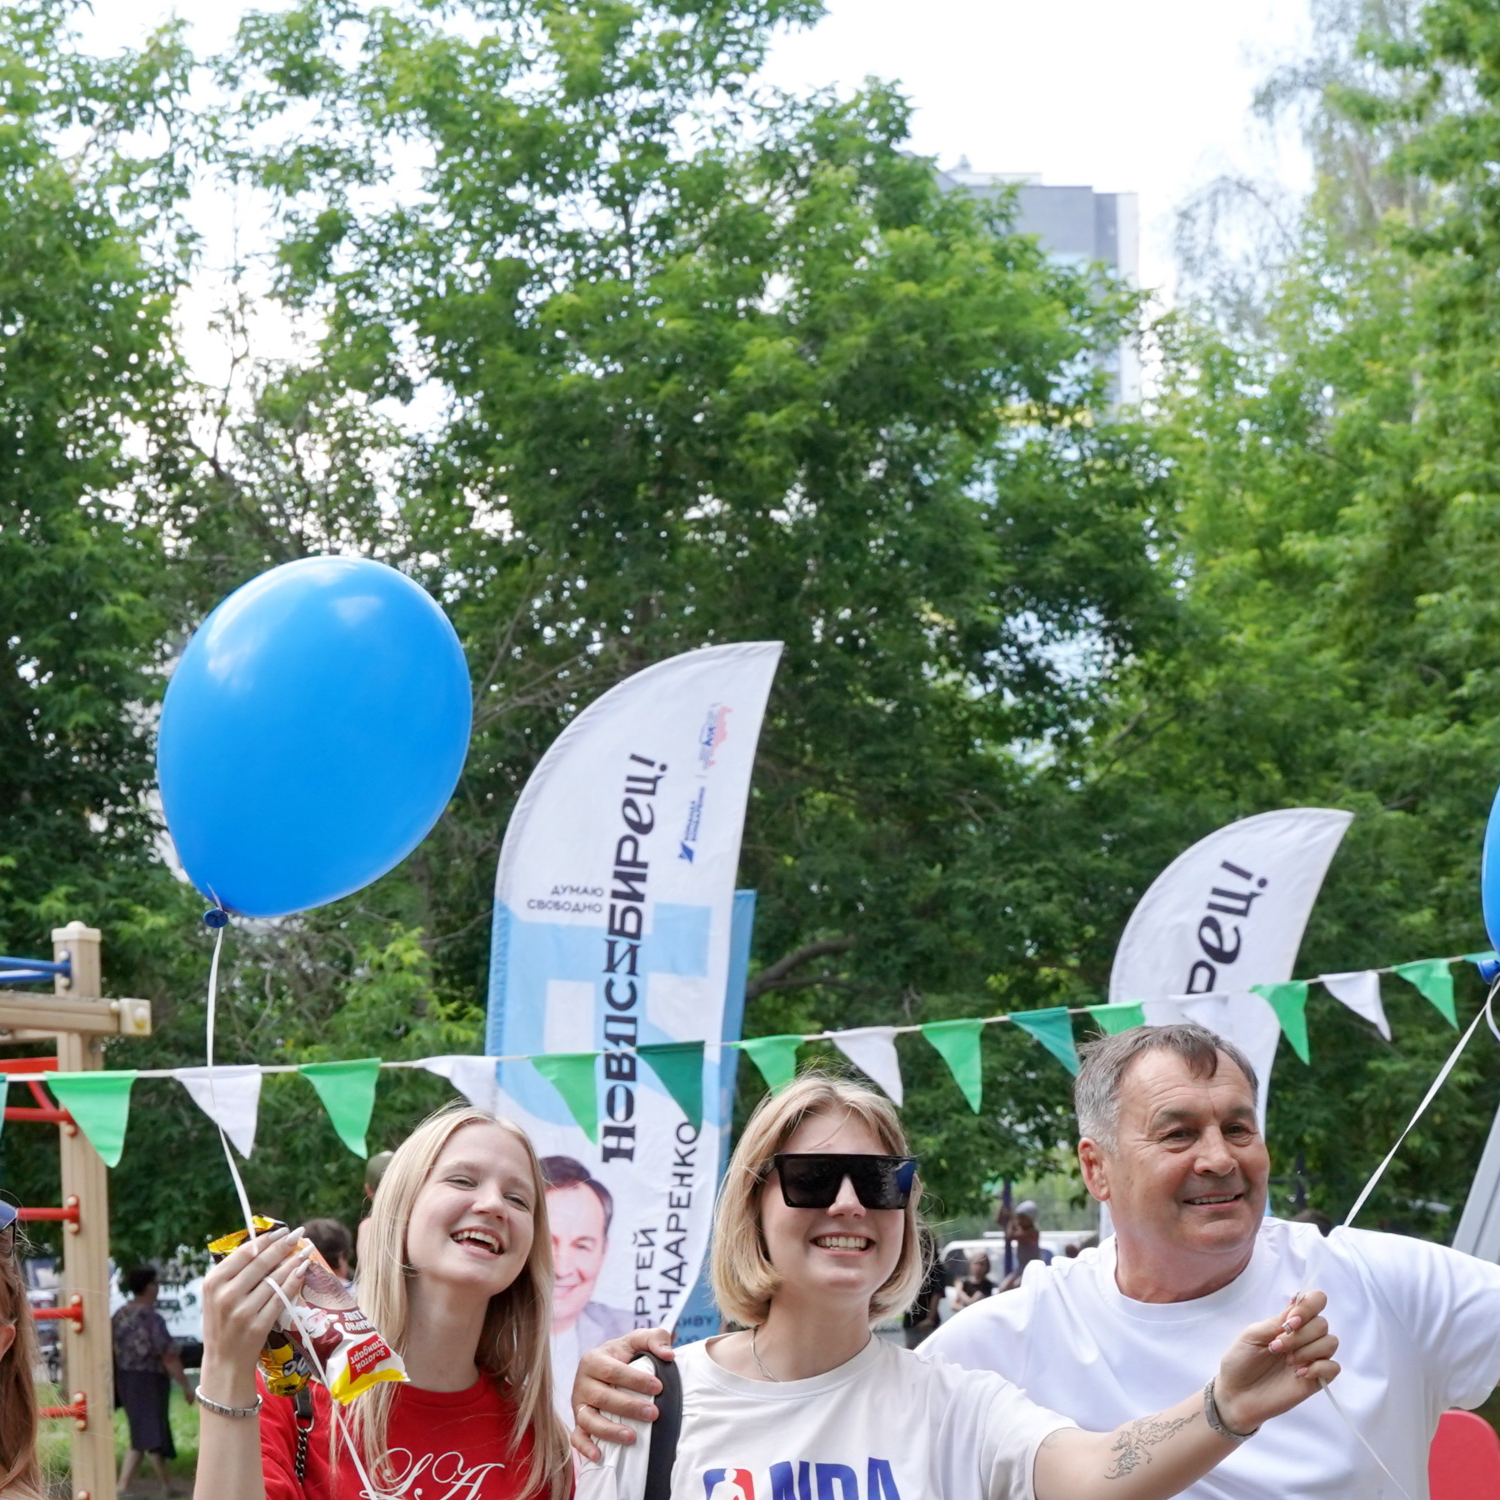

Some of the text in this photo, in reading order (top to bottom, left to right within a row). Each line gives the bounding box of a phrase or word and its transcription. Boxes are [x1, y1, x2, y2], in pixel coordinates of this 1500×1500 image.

[550, 884, 604, 898] ДУМАЮ
[527, 898, 603, 914] СВОБОДНО
[631, 1226, 658, 1330] ЕРГЕЙ
